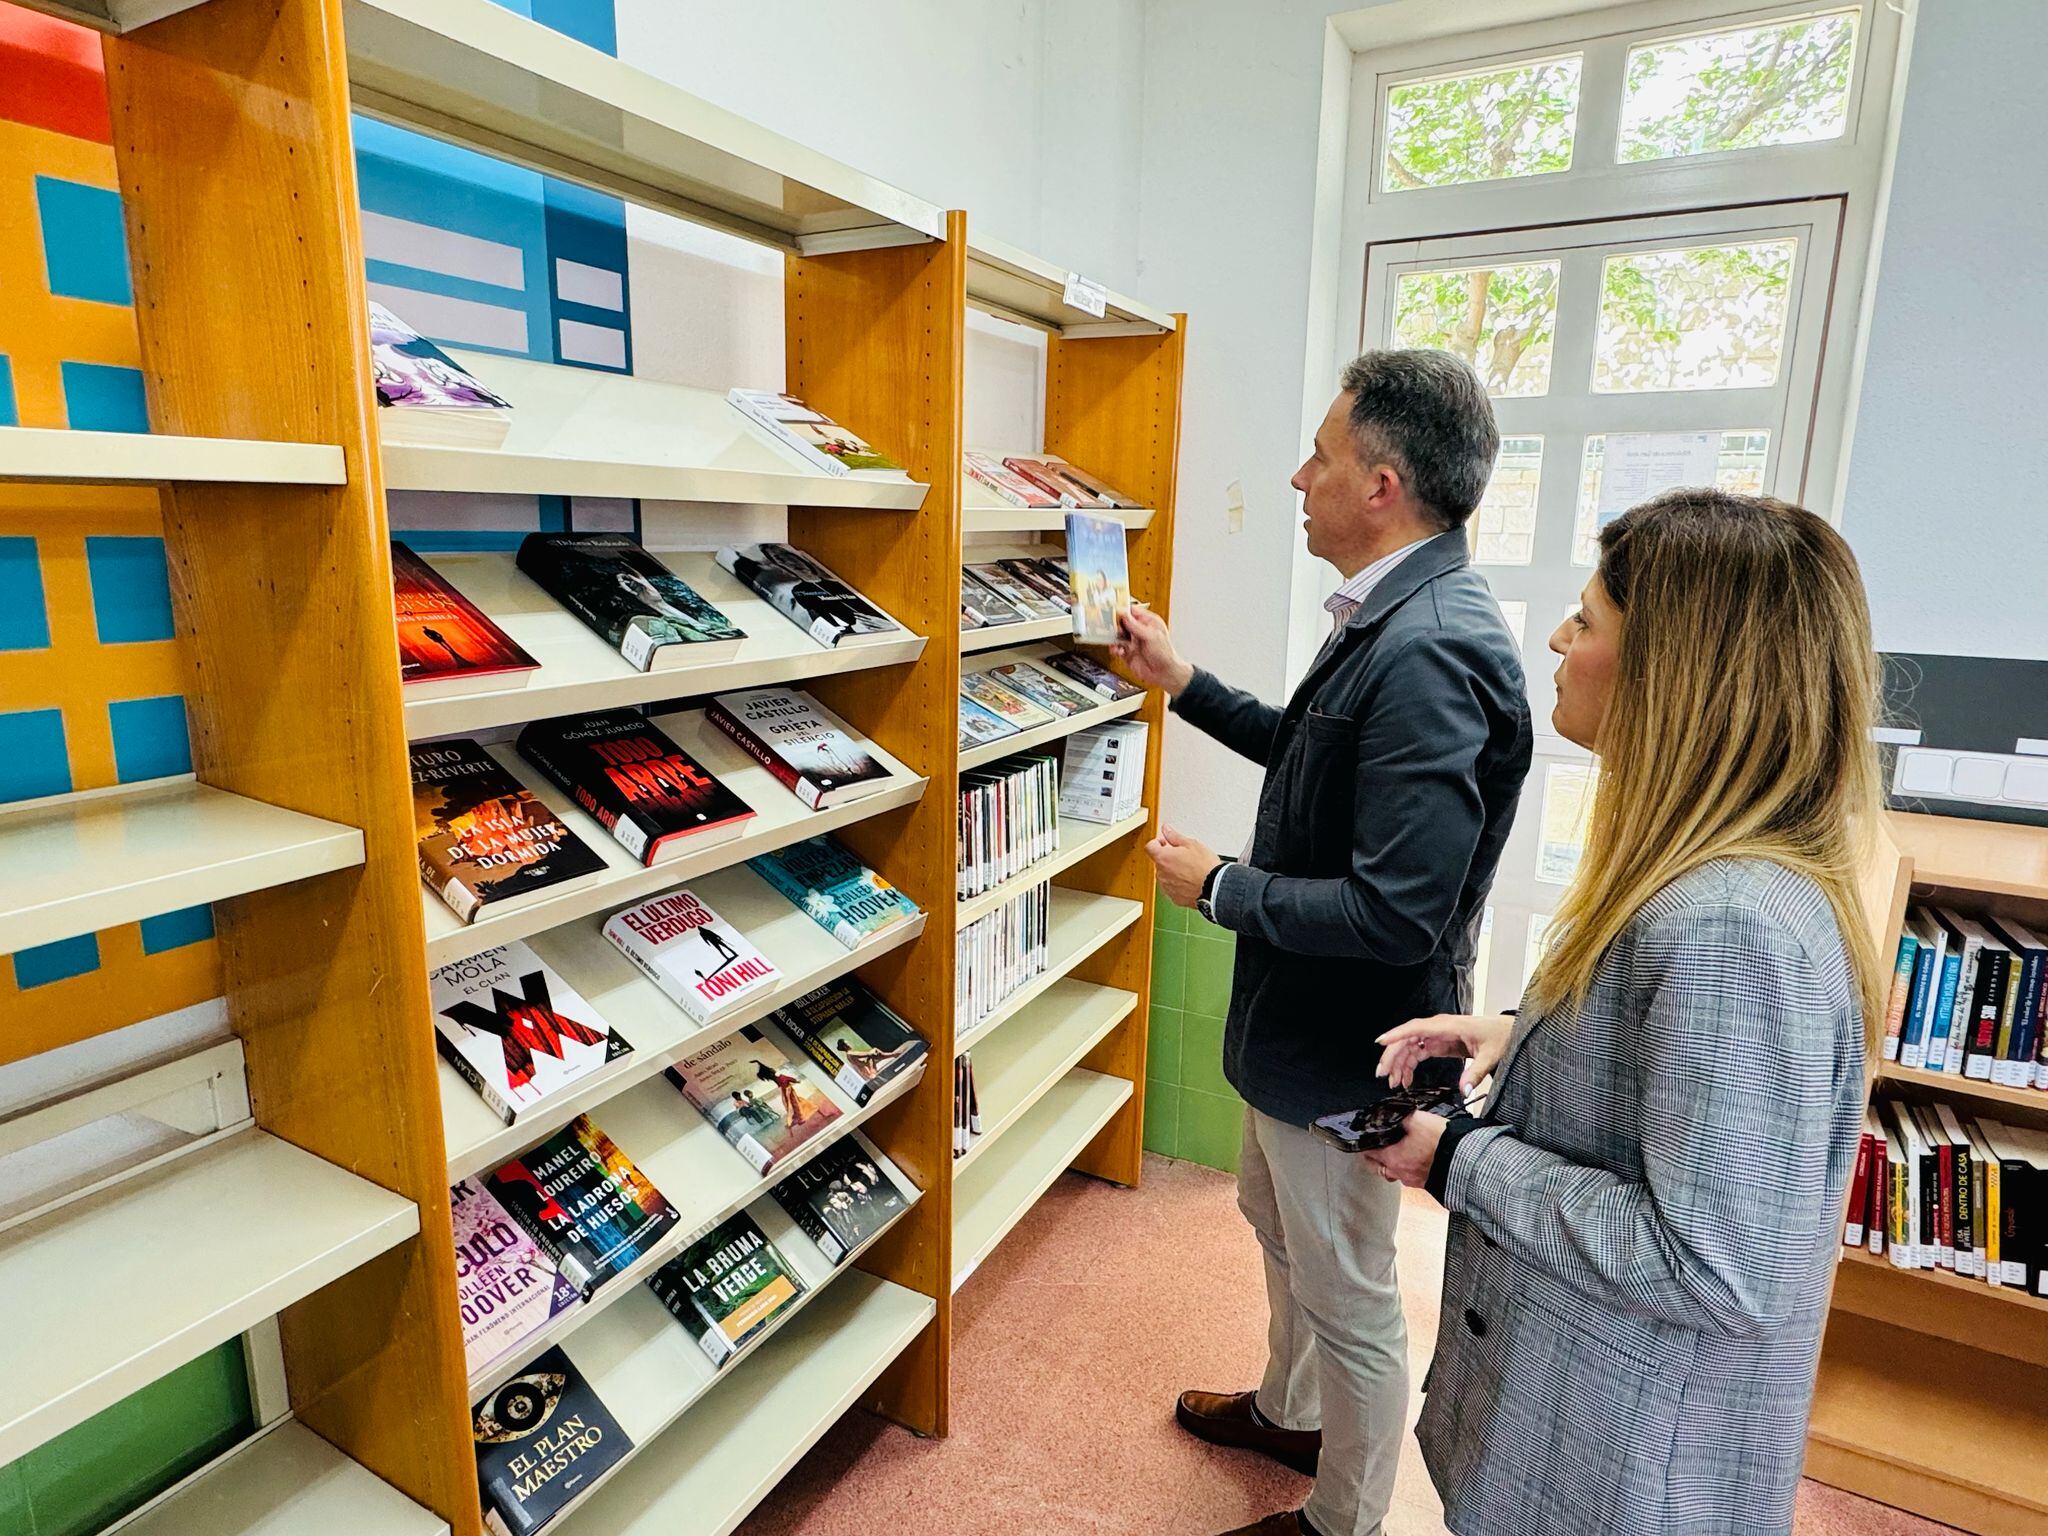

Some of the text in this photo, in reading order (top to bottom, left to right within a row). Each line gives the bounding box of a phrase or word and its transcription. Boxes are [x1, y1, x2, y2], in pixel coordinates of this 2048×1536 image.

[745, 697, 793, 711] JAVIER
[745, 704, 810, 720] CASTILLO
[584, 719, 610, 728] JUAN
[711, 711, 771, 765] JAVIER CASTILLO
[769, 720, 822, 734] GRIETA
[783, 732, 835, 747] SILENCIO
[588, 735, 664, 766] TODO
[603, 753, 713, 803] ARDE
[575, 784, 597, 812] TODO
[447, 822, 563, 860] DE LA MUJER
[456, 816, 525, 839] LA ISLA
[477, 840, 562, 870] DORMIDA
[621, 893, 700, 932] EL ÚLTIMO
[836, 889, 901, 925] HOOVER
[638, 909, 714, 945] VERDUGO
[444, 957, 506, 987] MOLA
[463, 971, 511, 995] EL CLAN
[696, 957, 774, 1002] TONI HILL
[1992, 955, 2000, 975] ALAN
[785, 1018, 805, 1039] DICKER
[453, 1055, 477, 1086] CLAN
[683, 1038, 732, 1070] de sándalo
[533, 1145, 581, 1181] MANEL
[535, 1151, 602, 1202] LOUREIRO
[547, 1165, 632, 1231] LA LADRONA
[1958, 1152, 1968, 1220] DENTRO DE CASA
[567, 1223, 589, 1244] DE
[587, 1183, 640, 1230] HUESOS
[682, 1268, 710, 1293] LA
[706, 1230, 763, 1276] BRUMA
[479, 1312, 510, 1337] FENÓMENO
[508, 1285, 551, 1316] INTERNACIONAL
[507, 1414, 586, 1480] EL PLAN
[511, 1425, 603, 1503] MAESTRO
